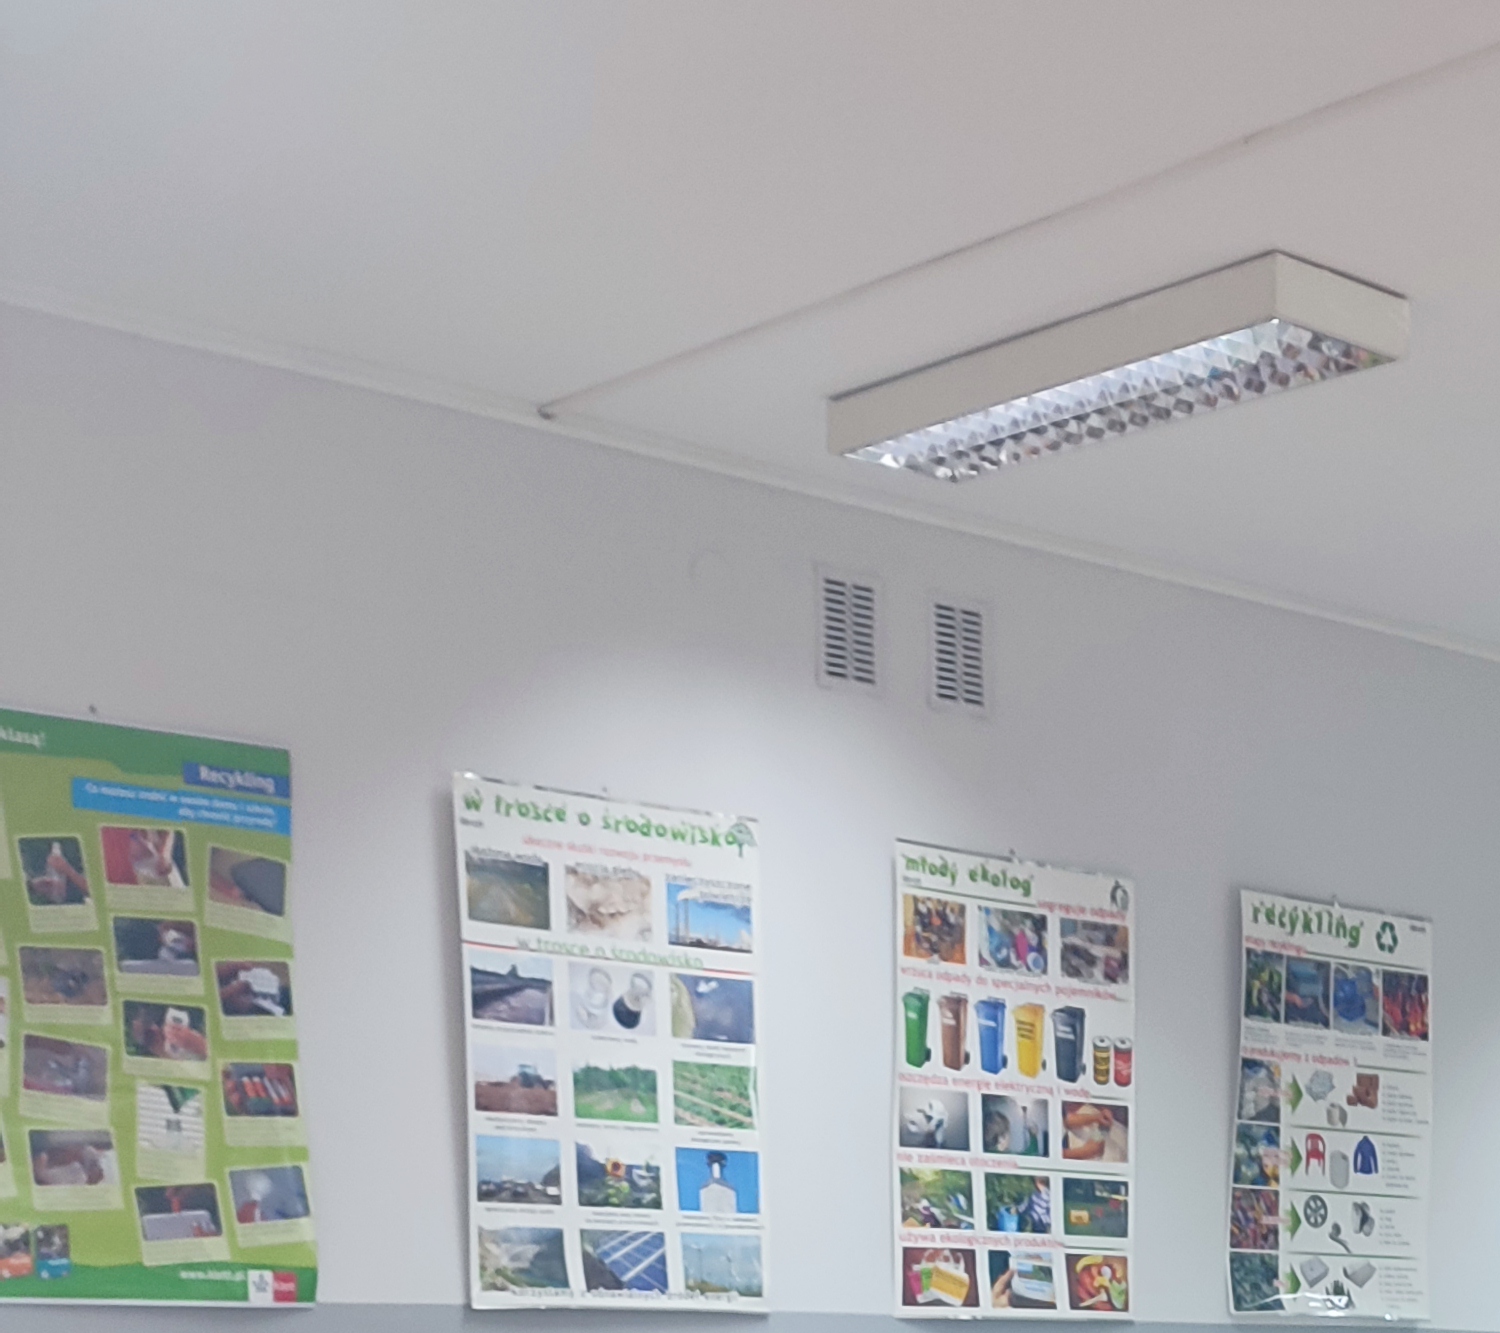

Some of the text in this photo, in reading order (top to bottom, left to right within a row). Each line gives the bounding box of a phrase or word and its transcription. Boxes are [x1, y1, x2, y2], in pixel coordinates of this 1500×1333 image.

[199, 765, 275, 794] Recykling
[462, 789, 740, 847] w trosce o środowisko
[903, 855, 1034, 897] młody ekolog
[1252, 901, 1363, 948] recykling
